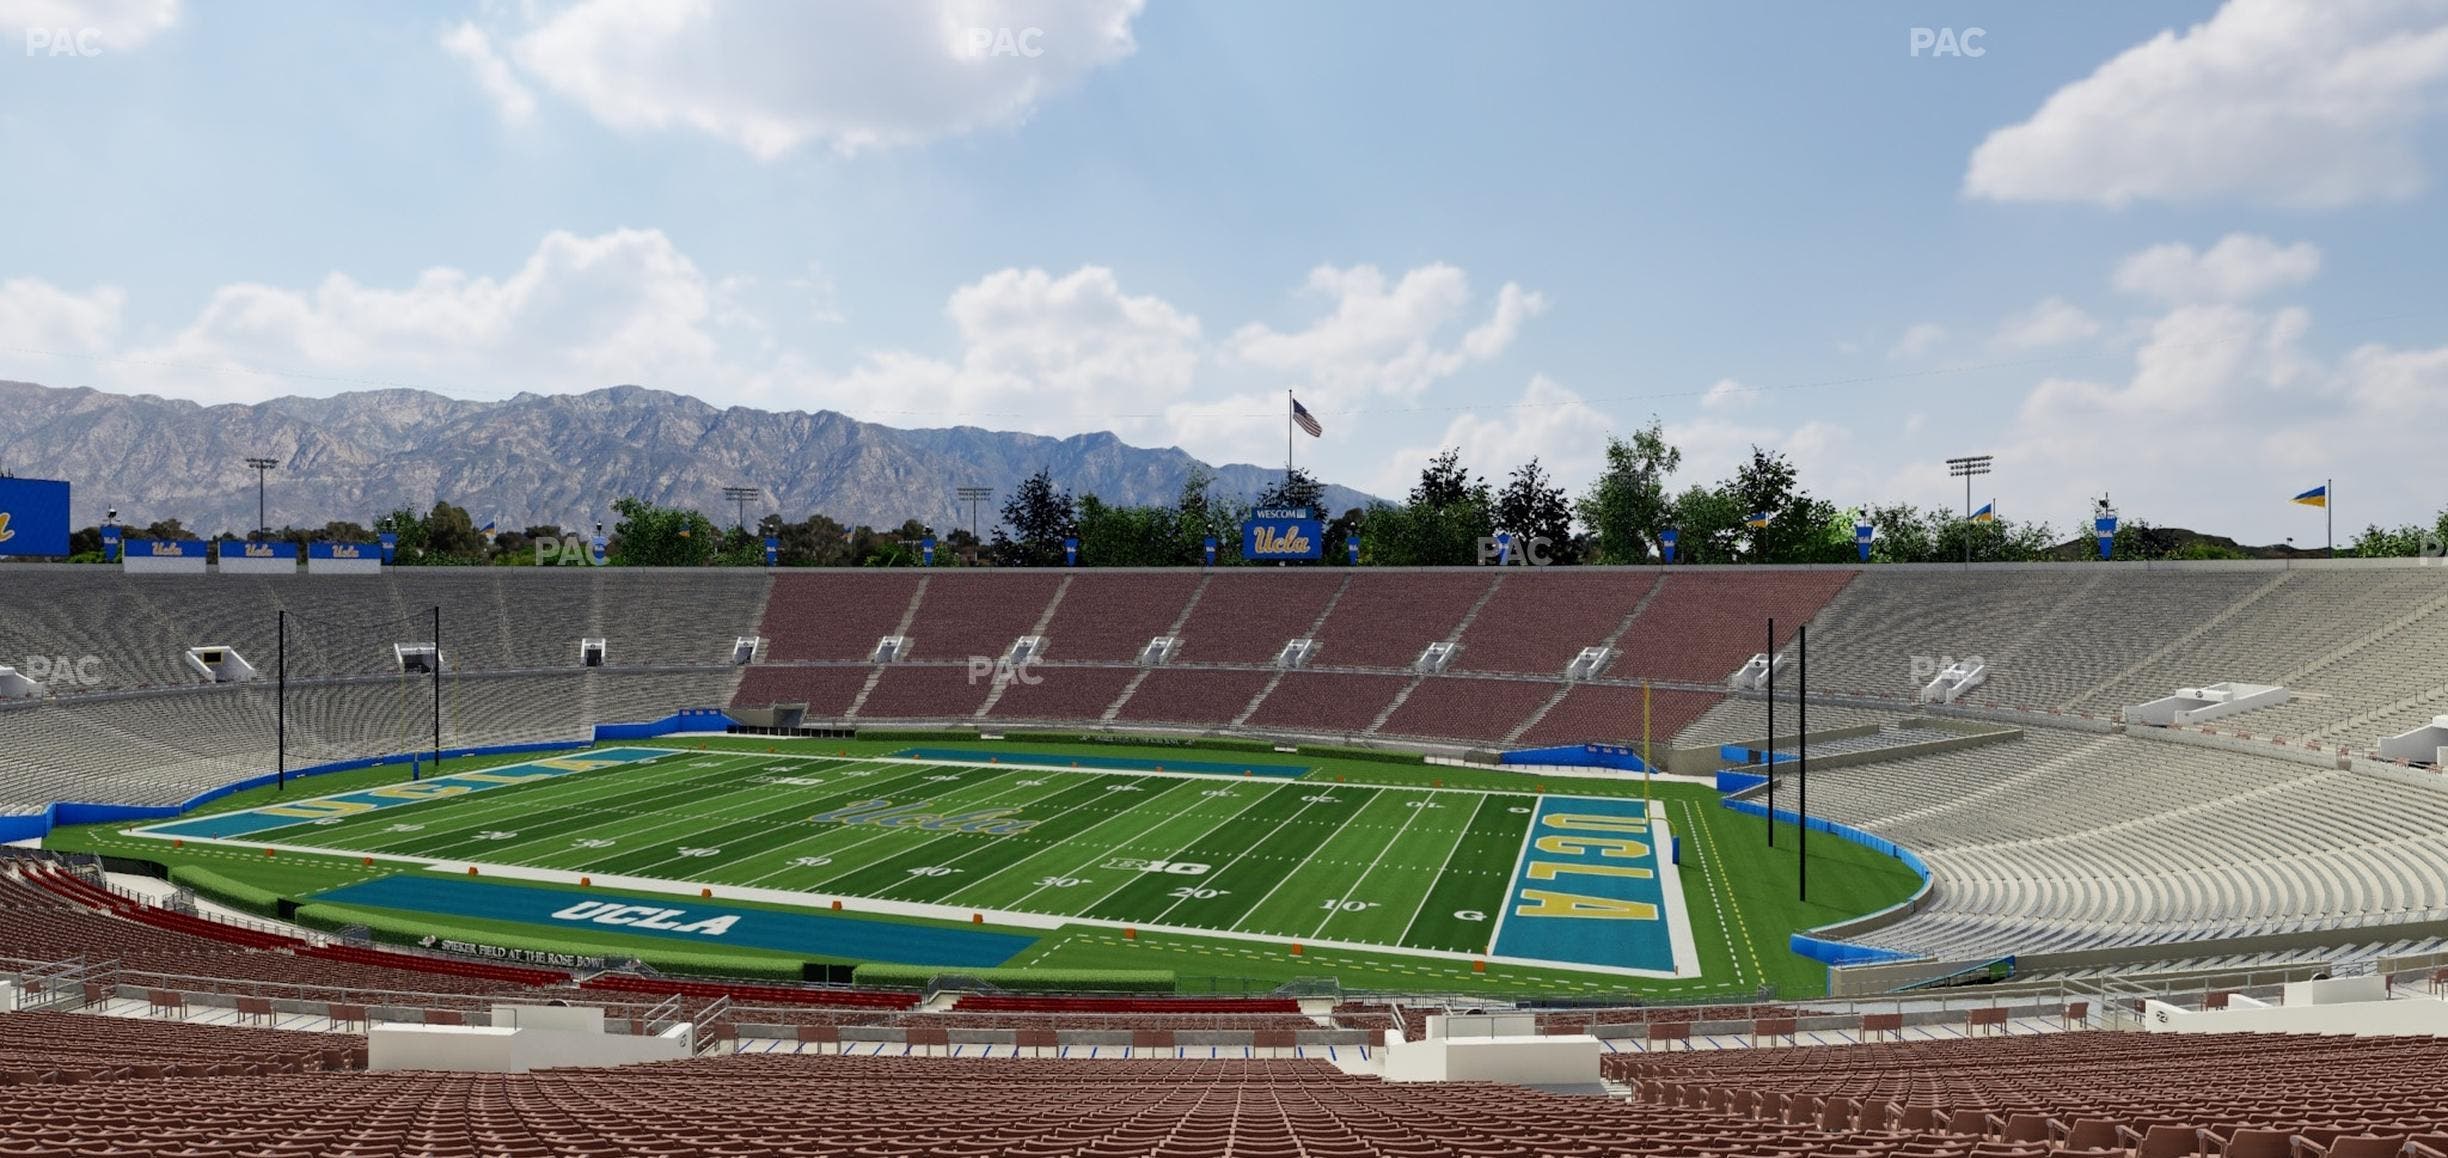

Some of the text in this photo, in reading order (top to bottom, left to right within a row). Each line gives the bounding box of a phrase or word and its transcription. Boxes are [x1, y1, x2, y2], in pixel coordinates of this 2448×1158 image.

[1256, 509, 1297, 519] WESCOM
[1254, 525, 1311, 554] Ucla
[1516, 812, 1659, 921] UCLA
[1033, 876, 1080, 887] 30
[1167, 887, 1218, 899] 20
[1319, 898, 1368, 912] 10
[551, 901, 742, 936] UCLA
[1453, 909, 1487, 922] G
[479, 944, 506, 958] FIELD
[508, 949, 524, 960] AT
[525, 950, 546, 962] THE
[548, 953, 574, 966] ROSE
